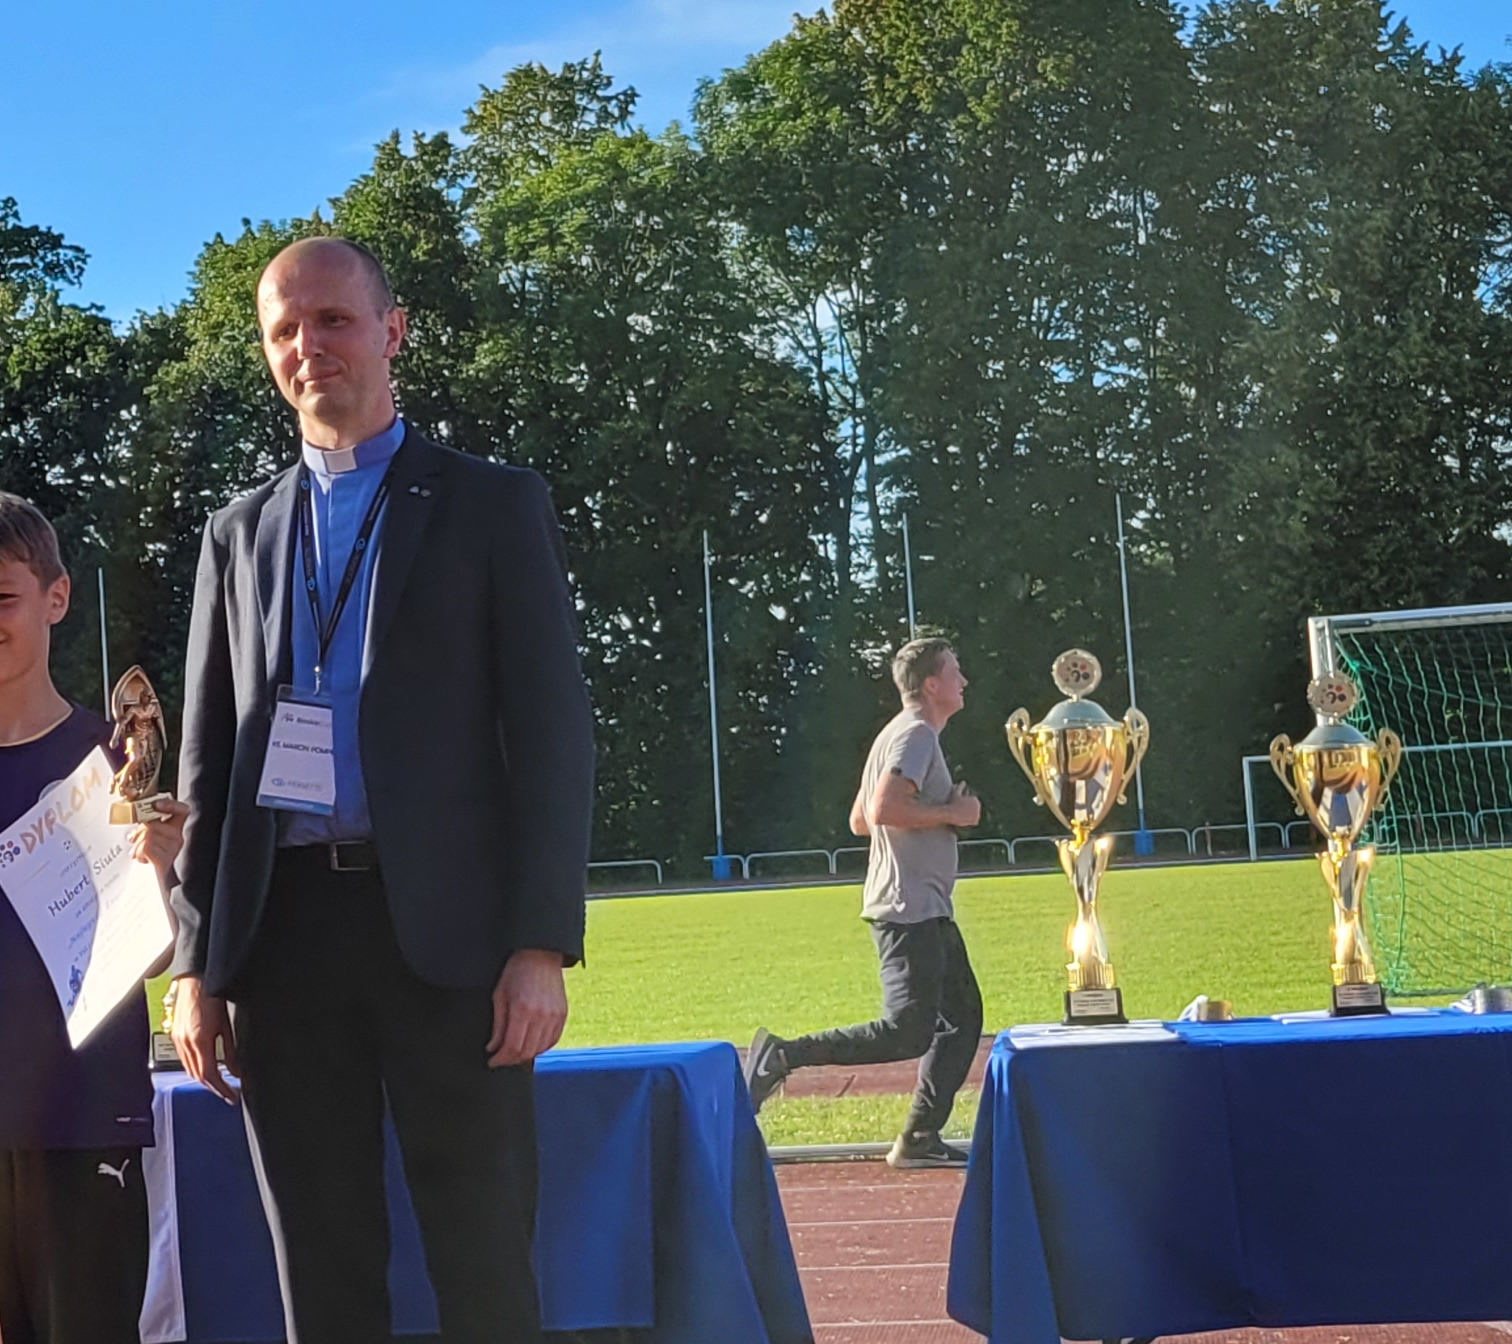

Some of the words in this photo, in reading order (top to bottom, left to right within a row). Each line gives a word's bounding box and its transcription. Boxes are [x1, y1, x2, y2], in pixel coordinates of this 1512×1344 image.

[19, 767, 102, 854] DYPLOM
[47, 874, 90, 917] Hubert
[92, 843, 123, 876] Siuta
